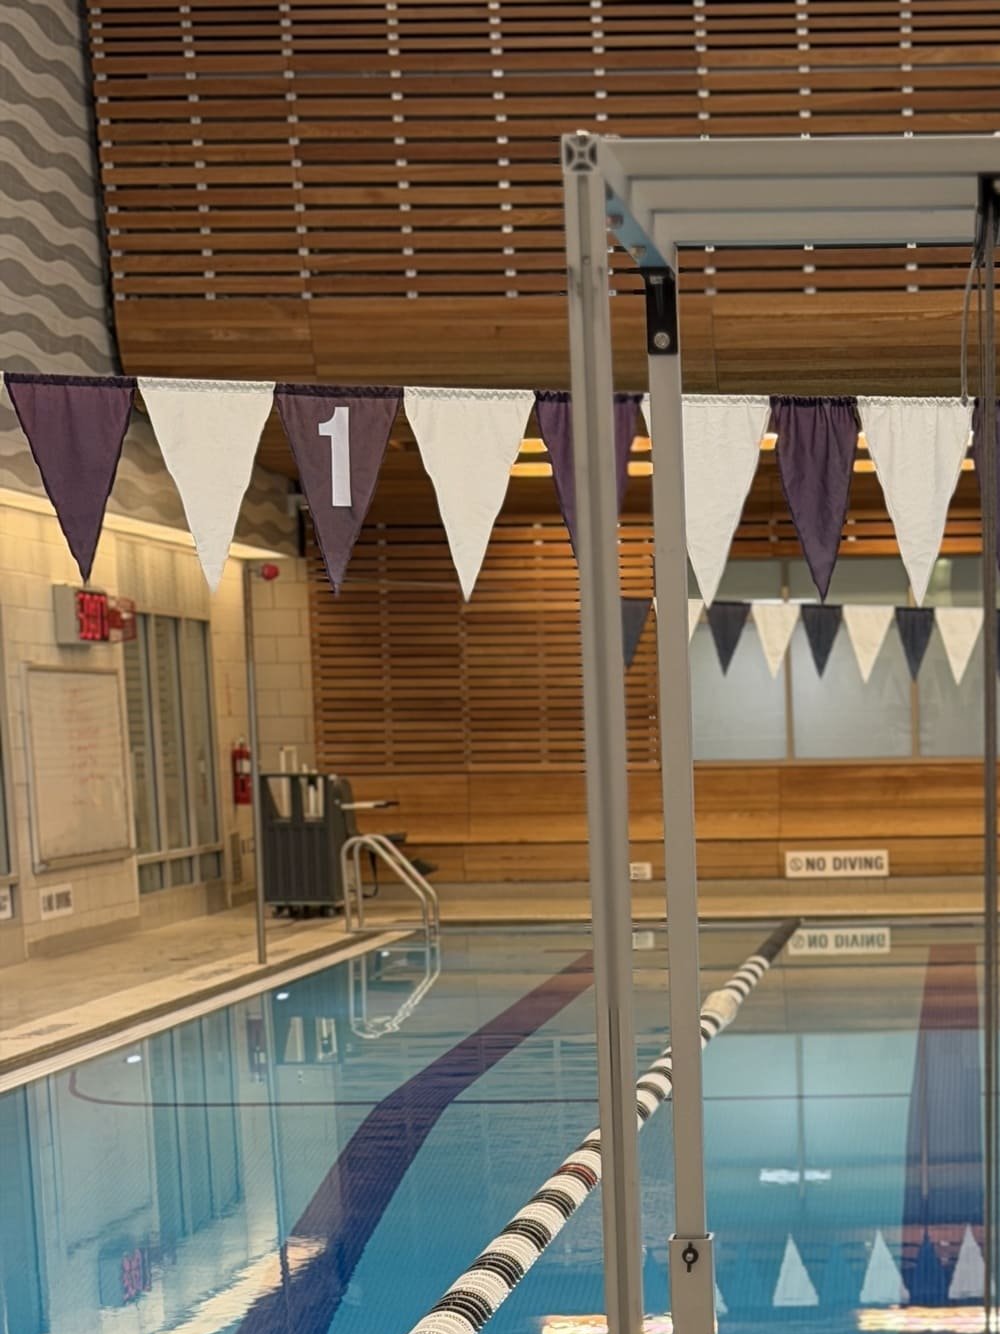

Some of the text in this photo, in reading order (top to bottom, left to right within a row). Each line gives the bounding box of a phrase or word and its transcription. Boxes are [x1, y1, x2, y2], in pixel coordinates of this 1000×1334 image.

[318, 406, 352, 507] 1
[805, 856, 884, 871] NO DIVING
